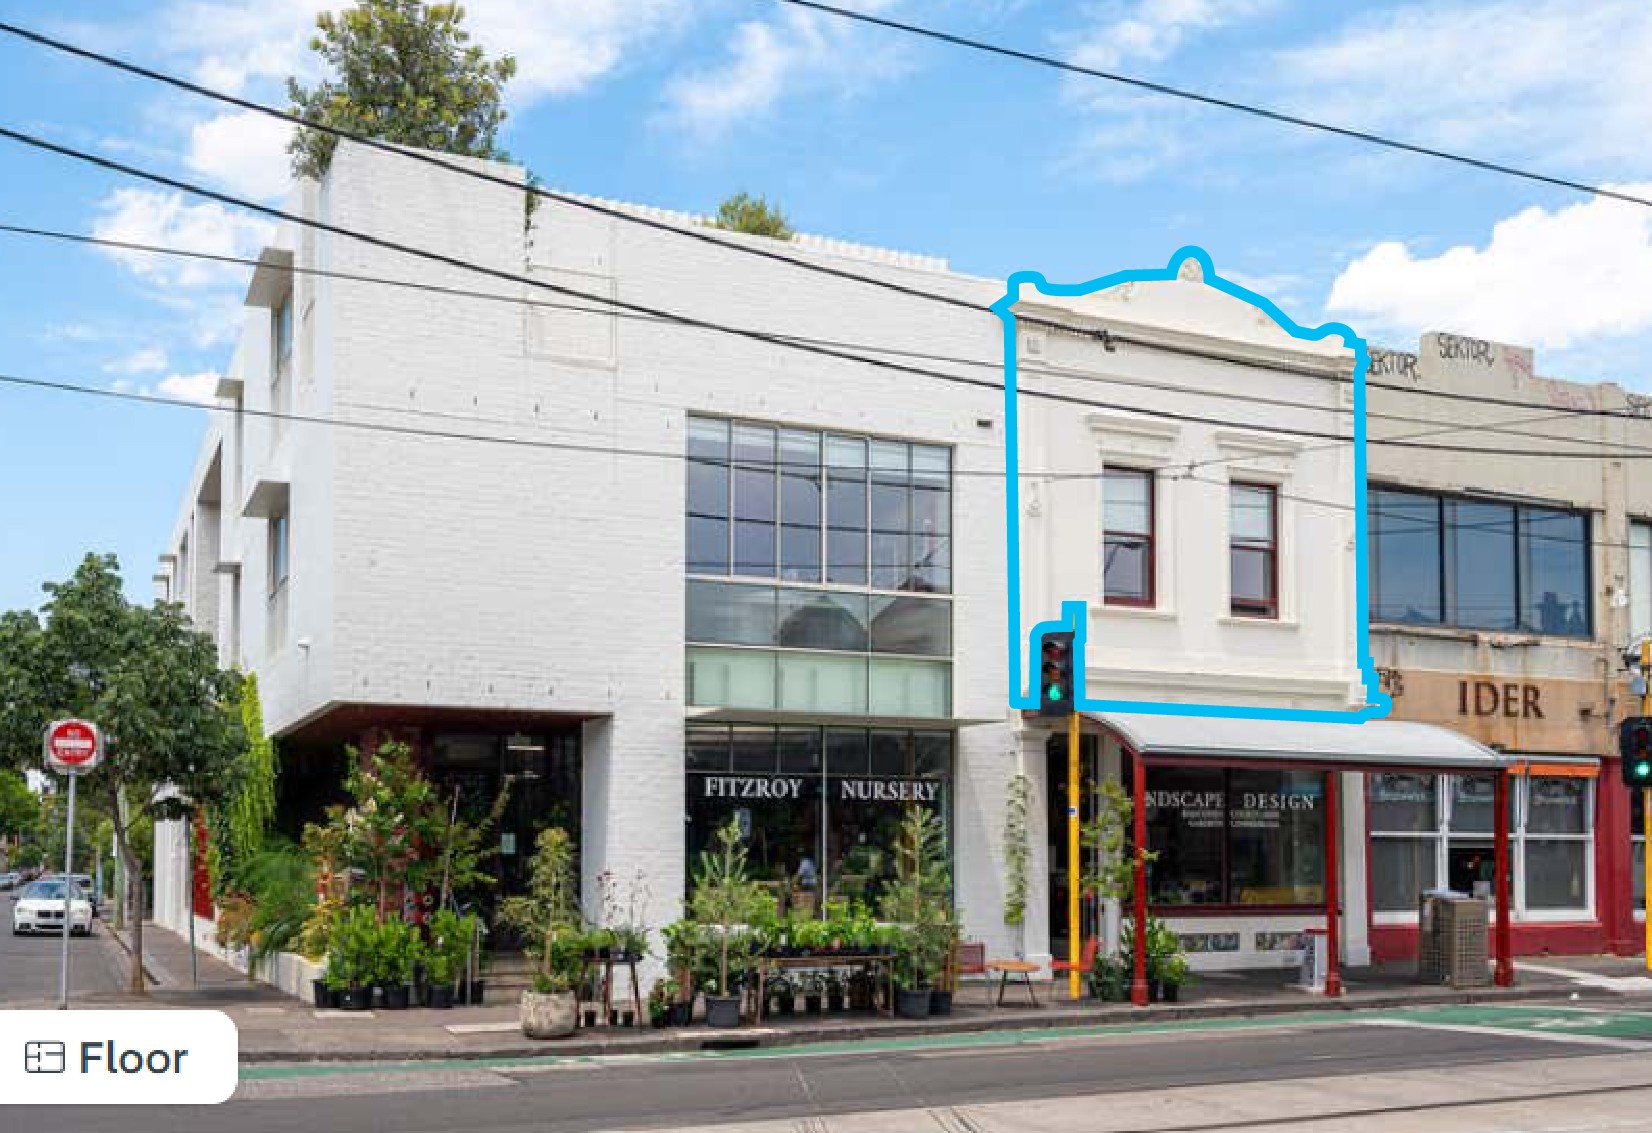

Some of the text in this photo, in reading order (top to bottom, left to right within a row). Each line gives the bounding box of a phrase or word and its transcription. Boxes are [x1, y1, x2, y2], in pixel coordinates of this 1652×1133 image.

[704, 776, 939, 801] FITZROY NURSERY
[1145, 791, 1315, 811] NDSCAPE DESIGN
